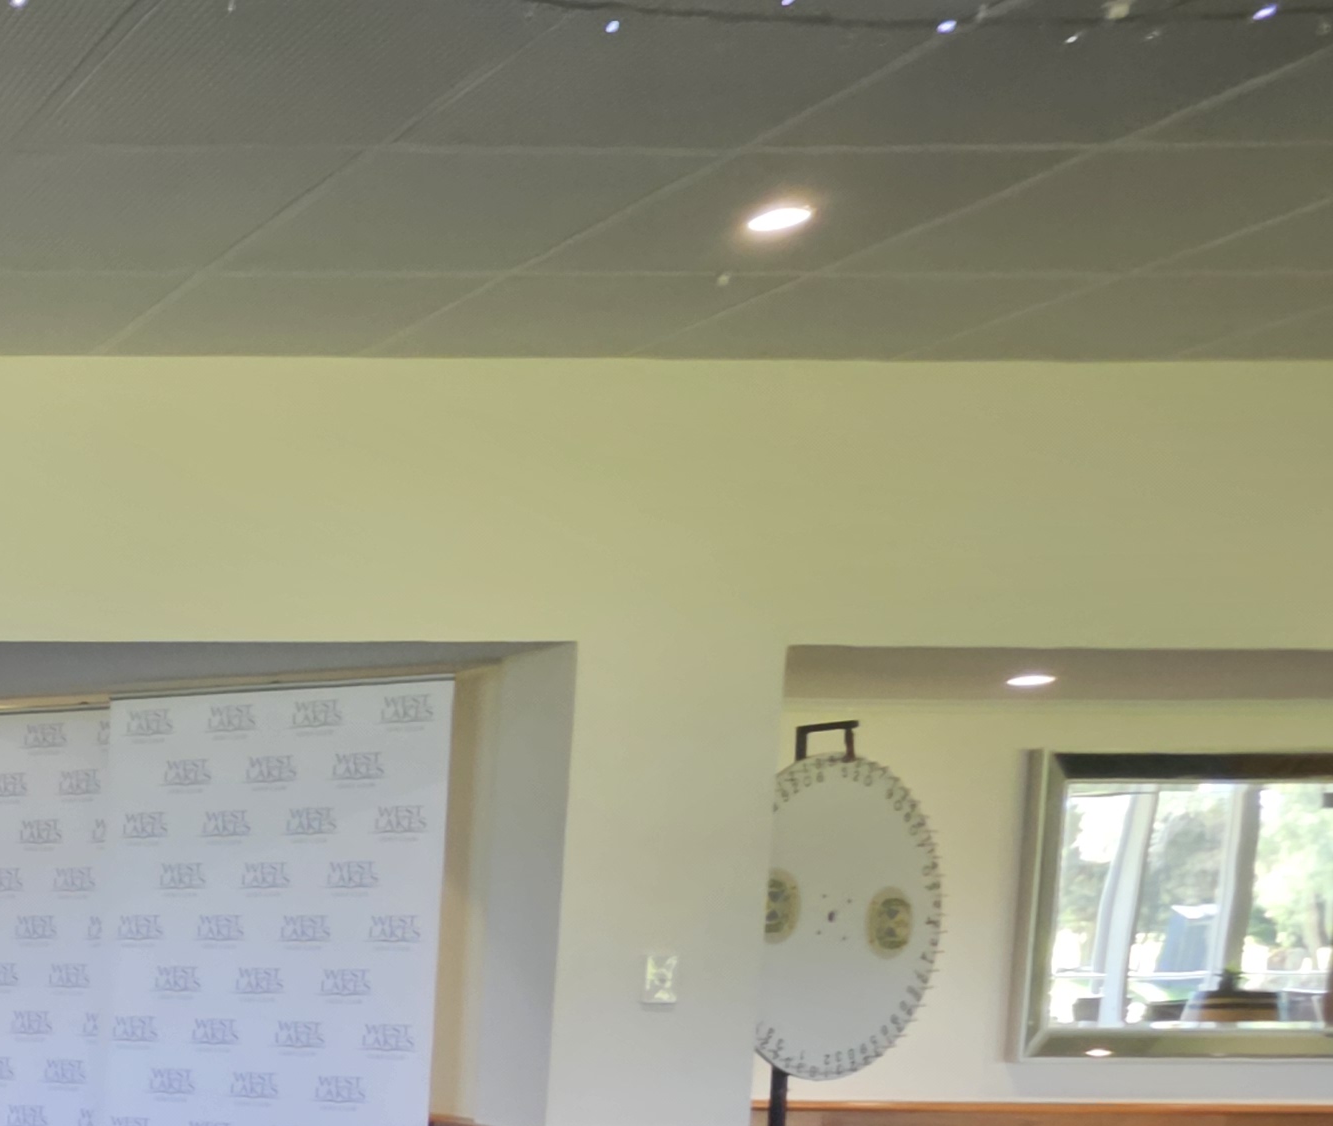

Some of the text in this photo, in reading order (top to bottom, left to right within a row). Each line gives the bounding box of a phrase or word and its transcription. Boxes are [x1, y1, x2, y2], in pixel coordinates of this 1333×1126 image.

[294, 699, 339, 712] WEST
[383, 693, 431, 707] WEST
[129, 708, 170, 721] WEST
[210, 704, 253, 716] WEST
[381, 705, 433, 720] LAKES
[208, 715, 255, 729] LAKES
[292, 710, 342, 724] LAKES
[127, 719, 172, 732] LAKES
[249, 755, 293, 767] WEST
[335, 751, 381, 764] WEST
[166, 758, 208, 770] WEST
[333, 763, 384, 776] LAKES
[164, 769, 211, 782] LAKES
[247, 766, 296, 779] LAKES
[205, 810, 248, 821] WEST
[289, 807, 333, 819] WEST
[377, 805, 424, 817] WEST
[124, 812, 165, 823] WEST
[374, 816, 427, 829] LAKES
[122, 822, 168, 835] LAKES
[202, 821, 250, 833] LAKES
[286, 818, 336, 831] LAKES
[161, 862, 203, 873] WEST
[243, 861, 287, 872] WEST
[329, 860, 375, 872] WEST
[159, 873, 206, 885] LAKES
[241, 873, 290, 885] LAKES
[327, 872, 378, 884] LAKES
[119, 914, 160, 924] WEST
[199, 914, 242, 925] WEST
[283, 915, 327, 925] WEST
[371, 915, 417, 926] WEST
[117, 925, 162, 936] LAKES
[196, 925, 244, 937] LAKES
[280, 926, 330, 938] LAKES
[368, 926, 420, 939] LAKES
[156, 965, 198, 976] WEST
[237, 967, 281, 978] WEST
[323, 968, 369, 979] WEST
[154, 976, 201, 988] LAKES
[235, 978, 284, 990] LAKES
[320, 979, 371, 992] LAKES
[114, 1015, 155, 1026] WEST
[194, 1017, 236, 1029] WEST
[277, 1020, 322, 1032] WEST
[112, 1026, 158, 1038] LAKES
[191, 1028, 239, 1041] LAKES
[364, 1023, 411, 1035] WEST
[275, 1031, 324, 1045] LAKES
[362, 1034, 414, 1048] LAKES
[151, 1067, 193, 1079] WEST
[232, 1071, 276, 1083] WEST
[149, 1078, 195, 1091] LAKES
[317, 1074, 363, 1087] WEST
[230, 1082, 278, 1095] LAKES
[315, 1086, 365, 1100] LAKES
